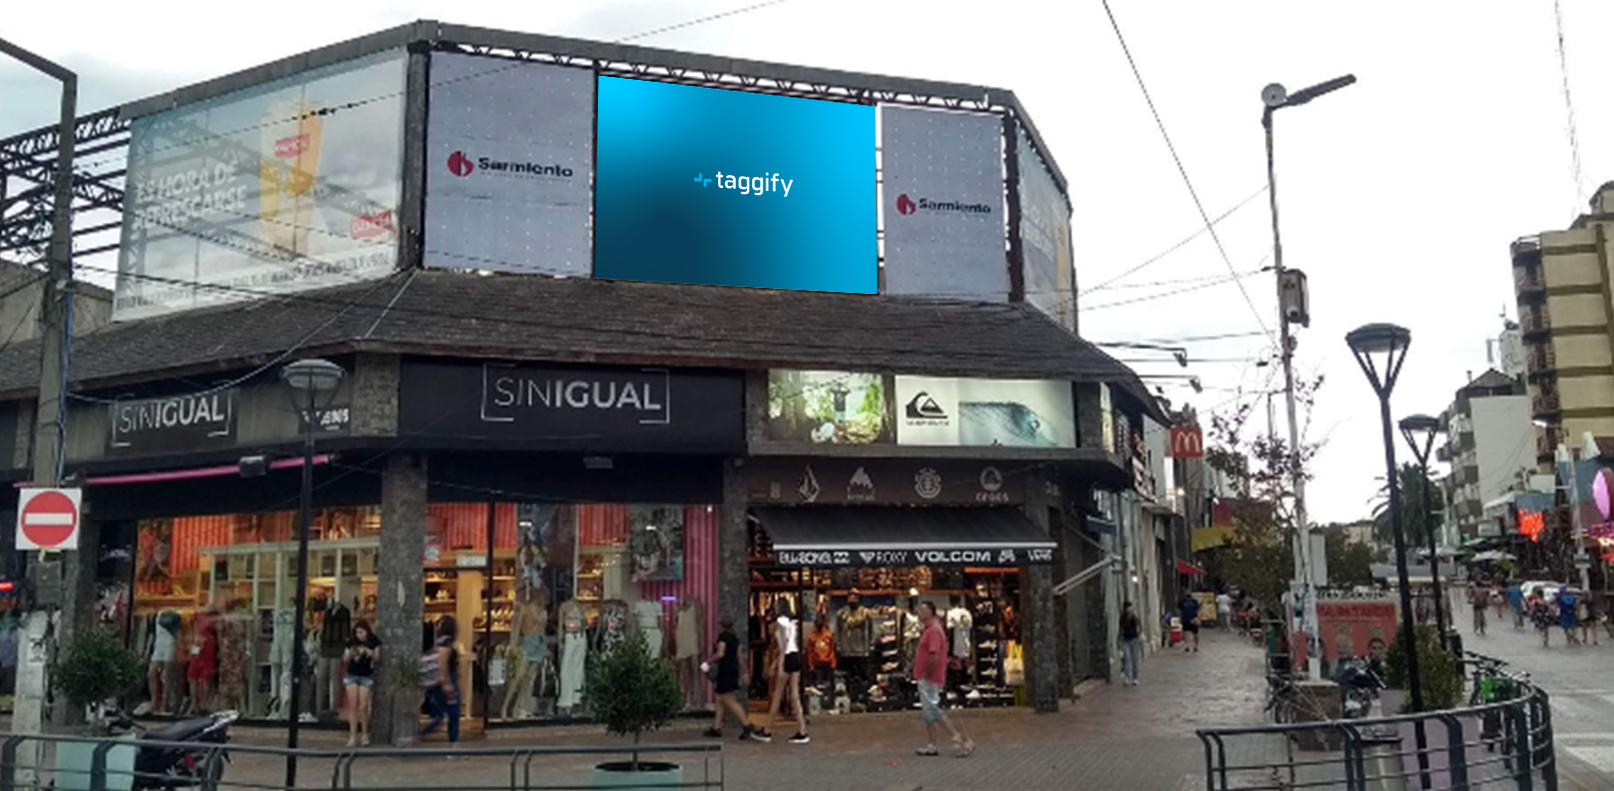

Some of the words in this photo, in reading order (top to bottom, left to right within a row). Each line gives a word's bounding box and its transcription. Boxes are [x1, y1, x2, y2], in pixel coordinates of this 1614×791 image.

[478, 157, 573, 177] Sarmiento
[716, 171, 793, 197] taggify
[919, 197, 991, 213] Sarmiento
[914, 550, 991, 563] VOLCOM
